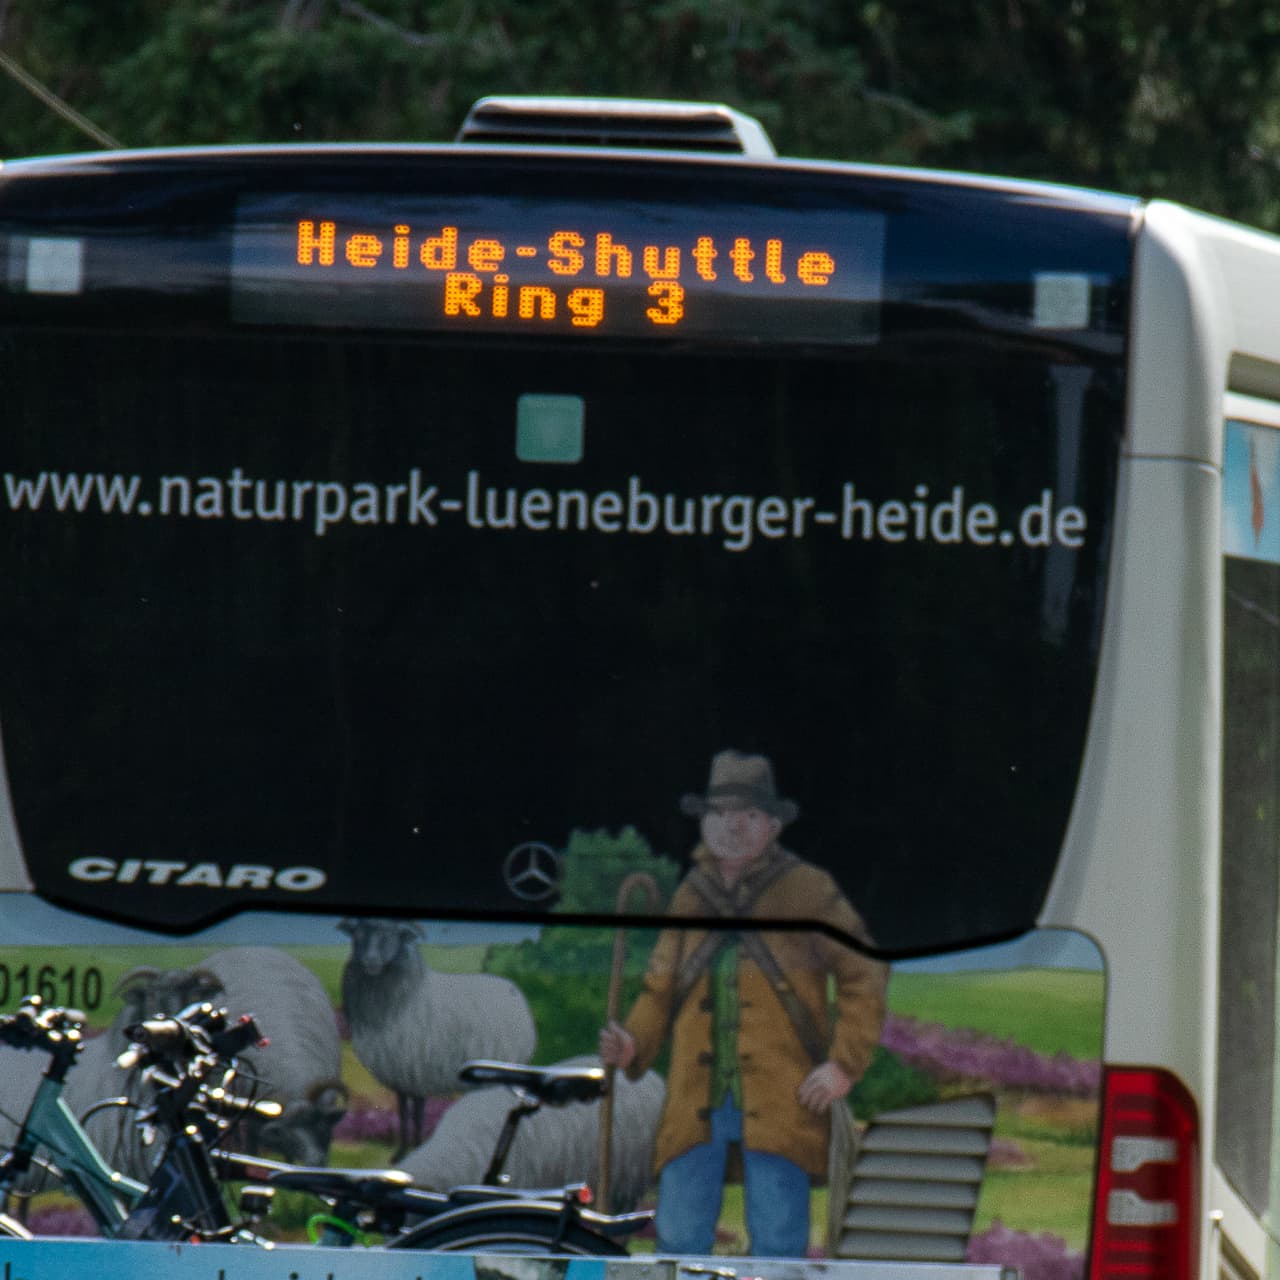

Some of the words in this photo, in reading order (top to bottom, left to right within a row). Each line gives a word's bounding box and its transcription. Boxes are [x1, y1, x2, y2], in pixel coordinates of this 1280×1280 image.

[296, 219, 837, 287] Heide-Shuttle
[444, 272, 605, 328] Ring
[645, 279, 686, 326] 3
[3, 467, 1089, 552] www.naturpark-lueneburger-heide.de
[69, 857, 327, 891] CITARO
